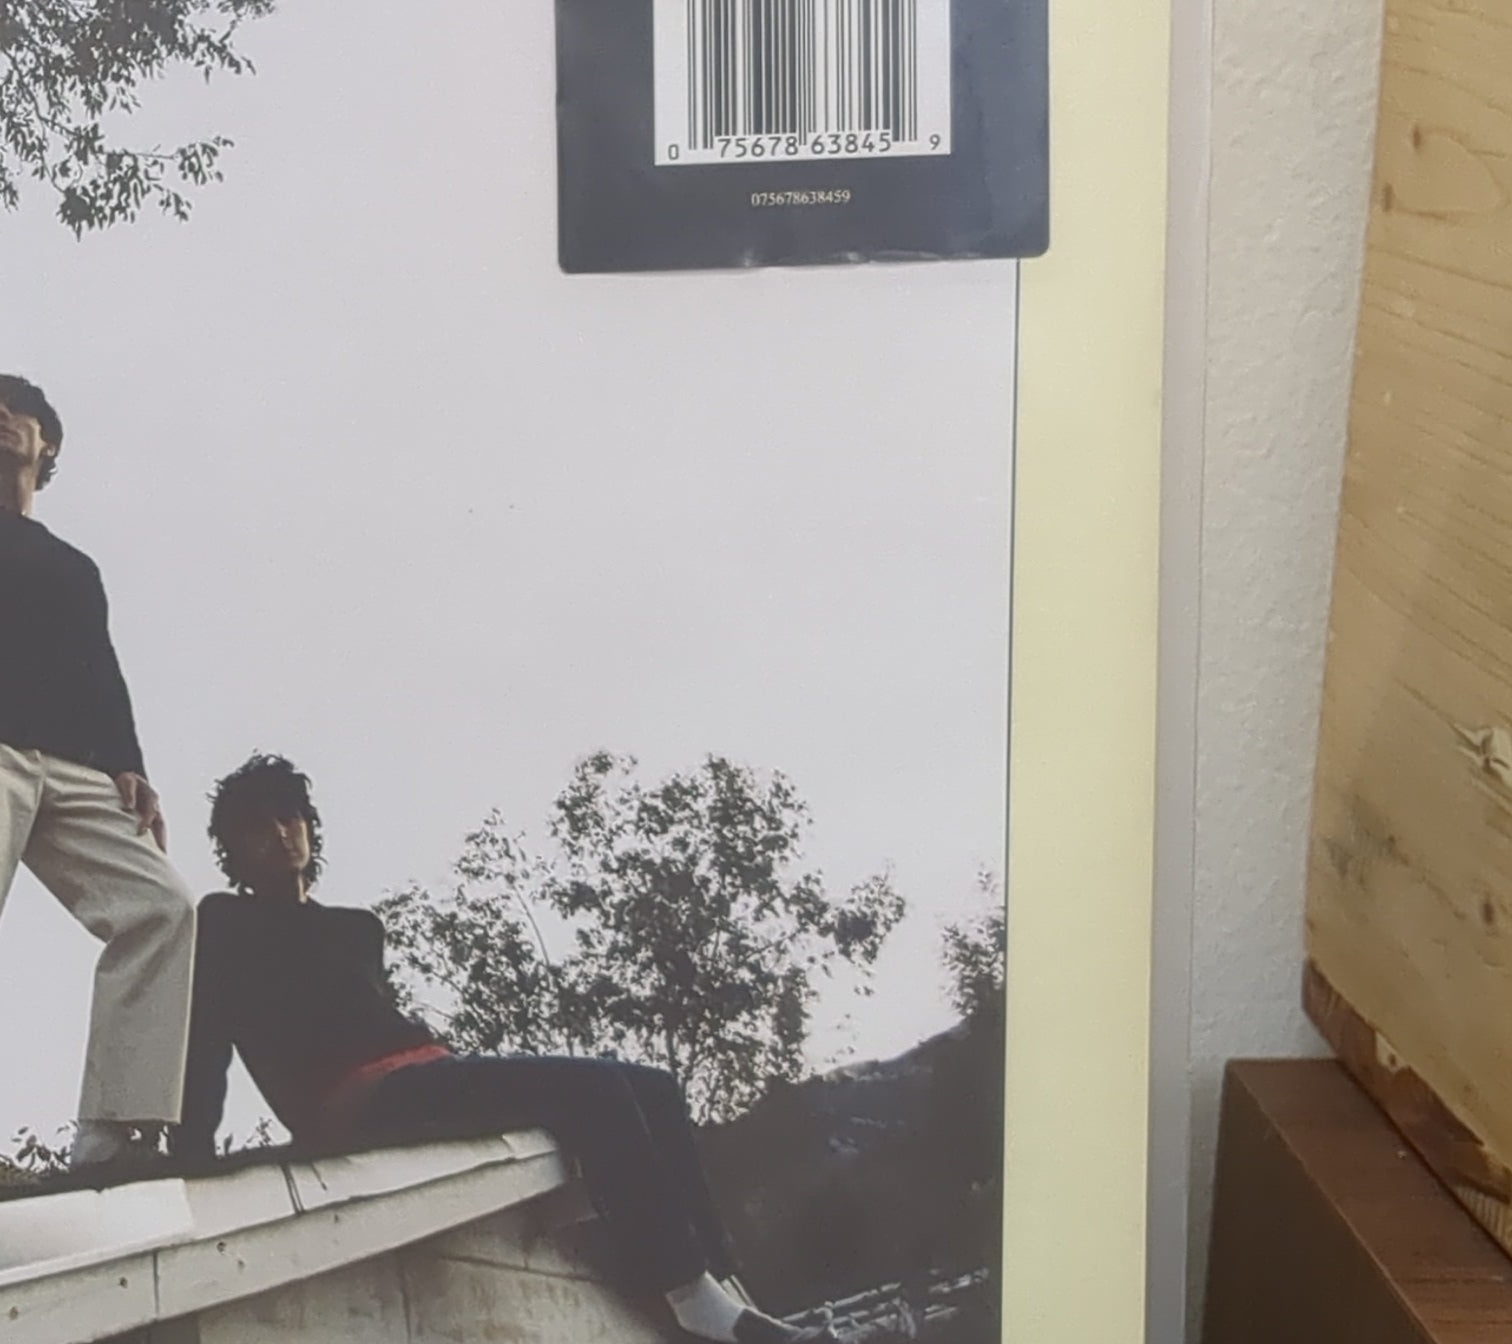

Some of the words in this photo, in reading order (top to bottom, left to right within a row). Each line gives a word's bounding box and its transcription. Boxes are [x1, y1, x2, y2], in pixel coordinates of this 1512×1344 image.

[718, 136, 799, 158] 75678
[811, 132, 892, 154] 63845
[929, 134, 941, 150] 9
[751, 190, 851, 207] 075678638459
